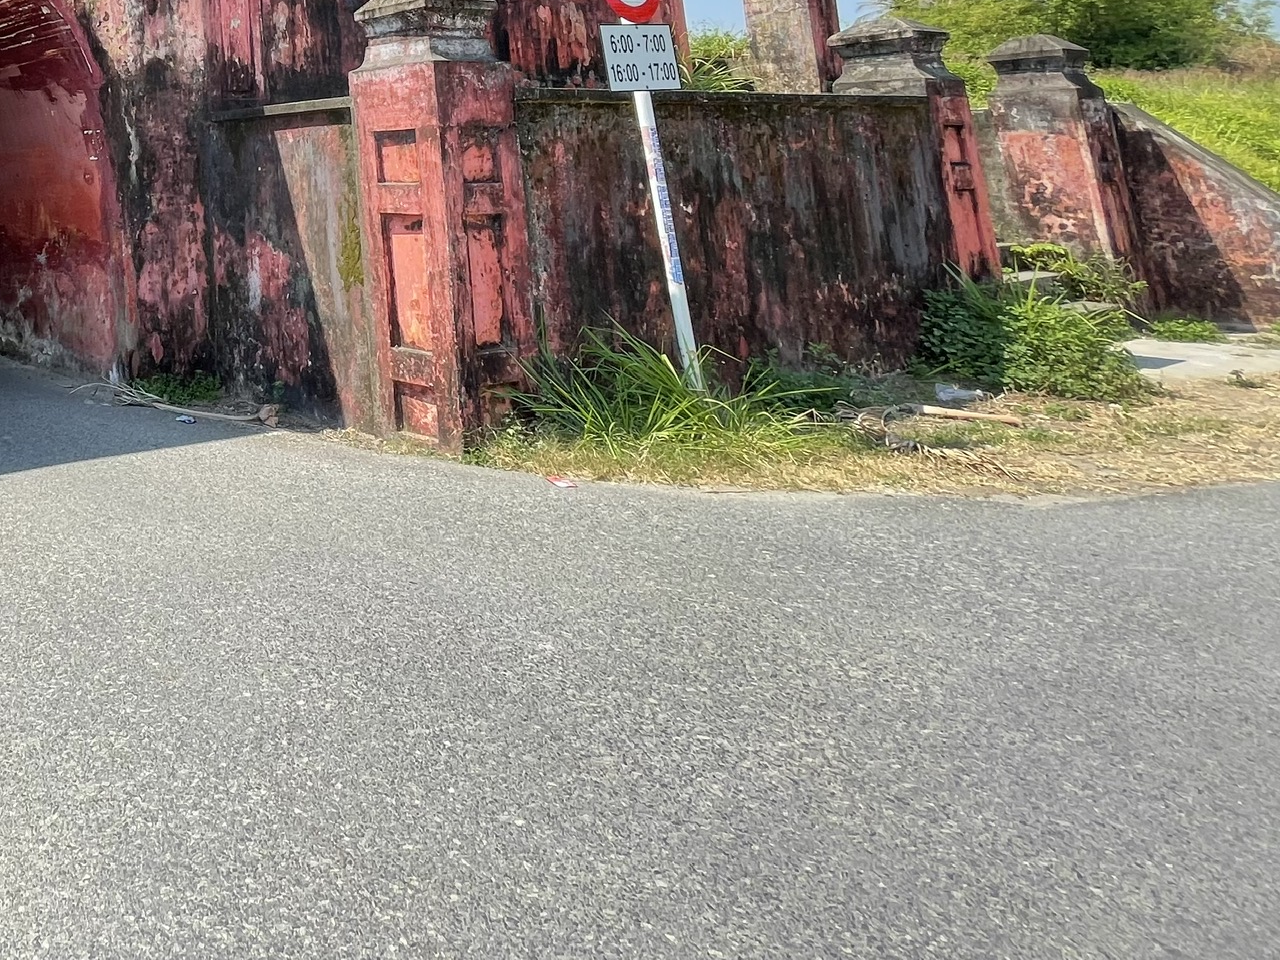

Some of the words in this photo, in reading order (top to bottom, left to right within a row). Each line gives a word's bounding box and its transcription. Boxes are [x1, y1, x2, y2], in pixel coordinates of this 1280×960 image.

[610, 34, 634, 53] 6:00
[642, 34, 666, 53] 7:00
[611, 63, 639, 83] 16:00
[648, 62, 676, 81] 17:00
